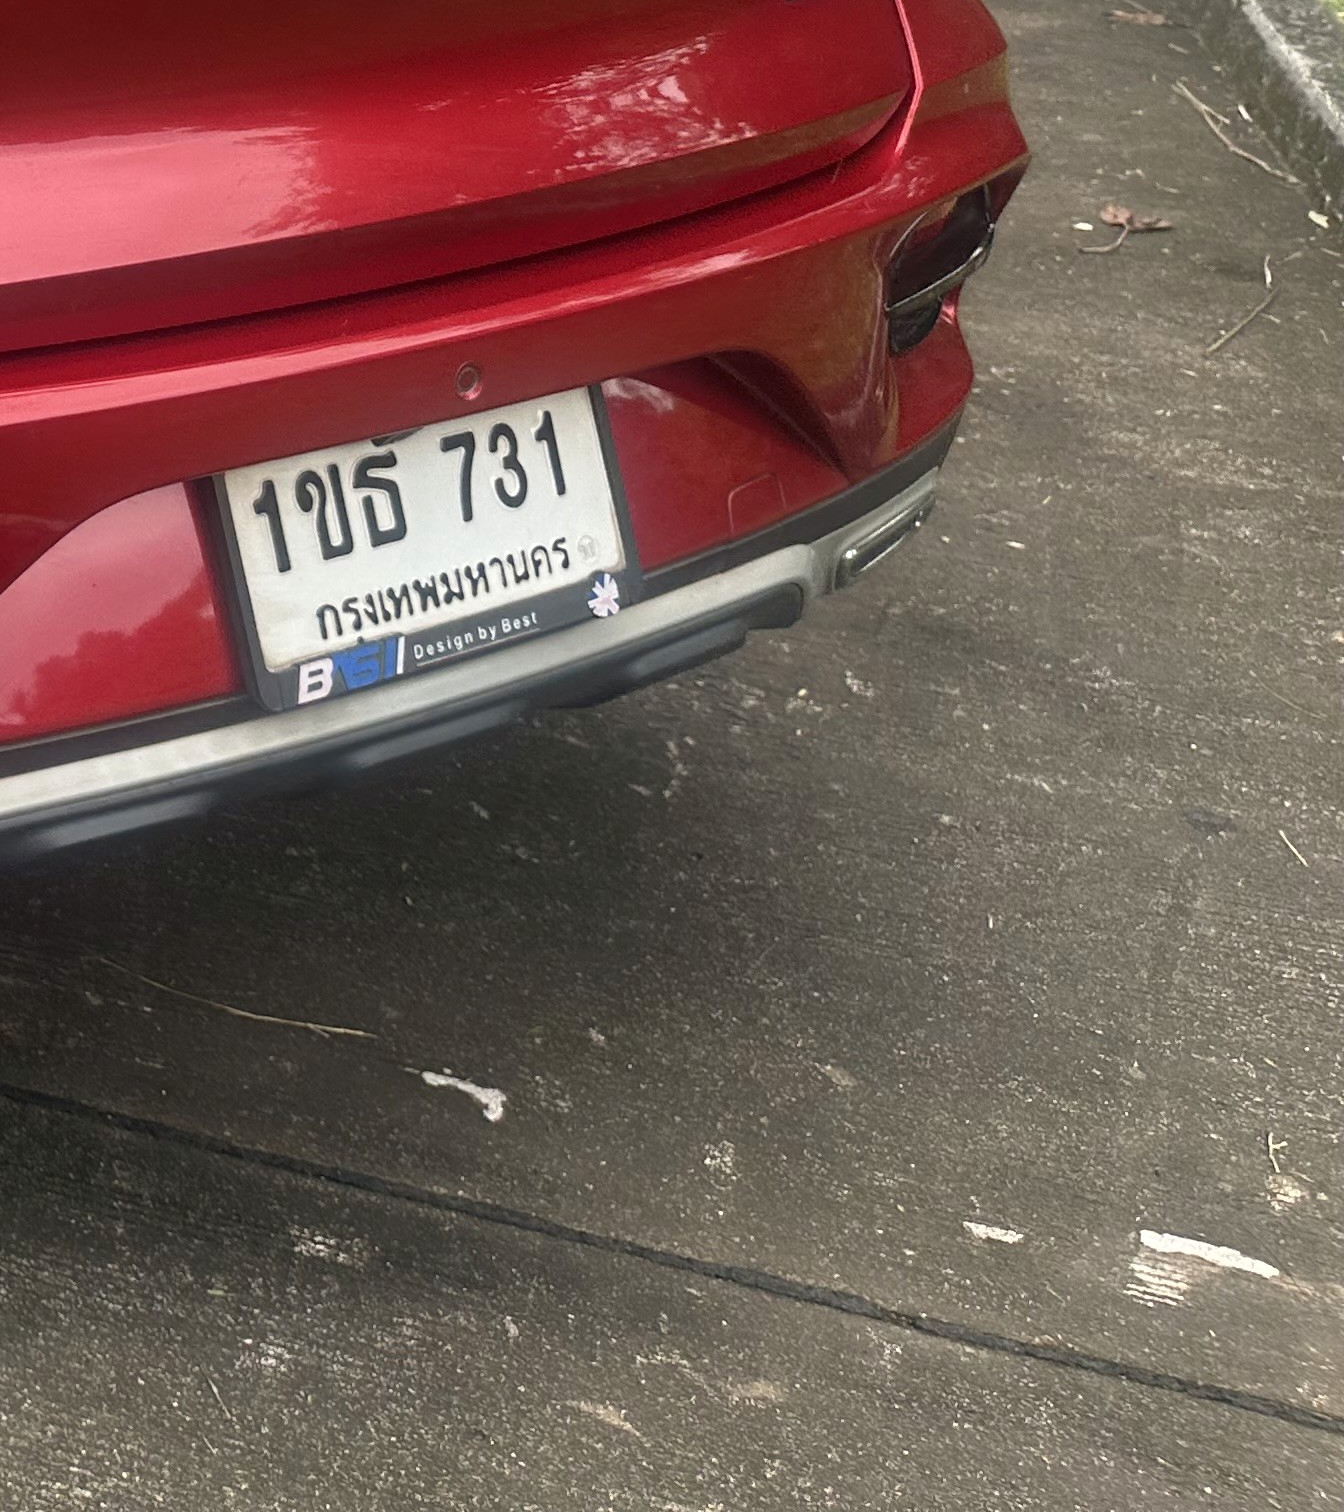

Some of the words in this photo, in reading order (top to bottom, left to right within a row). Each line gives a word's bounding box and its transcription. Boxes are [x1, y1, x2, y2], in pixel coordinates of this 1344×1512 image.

[440, 409, 568, 523] 731
[413, 631, 474, 661] Design
[478, 623, 498, 642] by
[501, 610, 539, 634] Best
